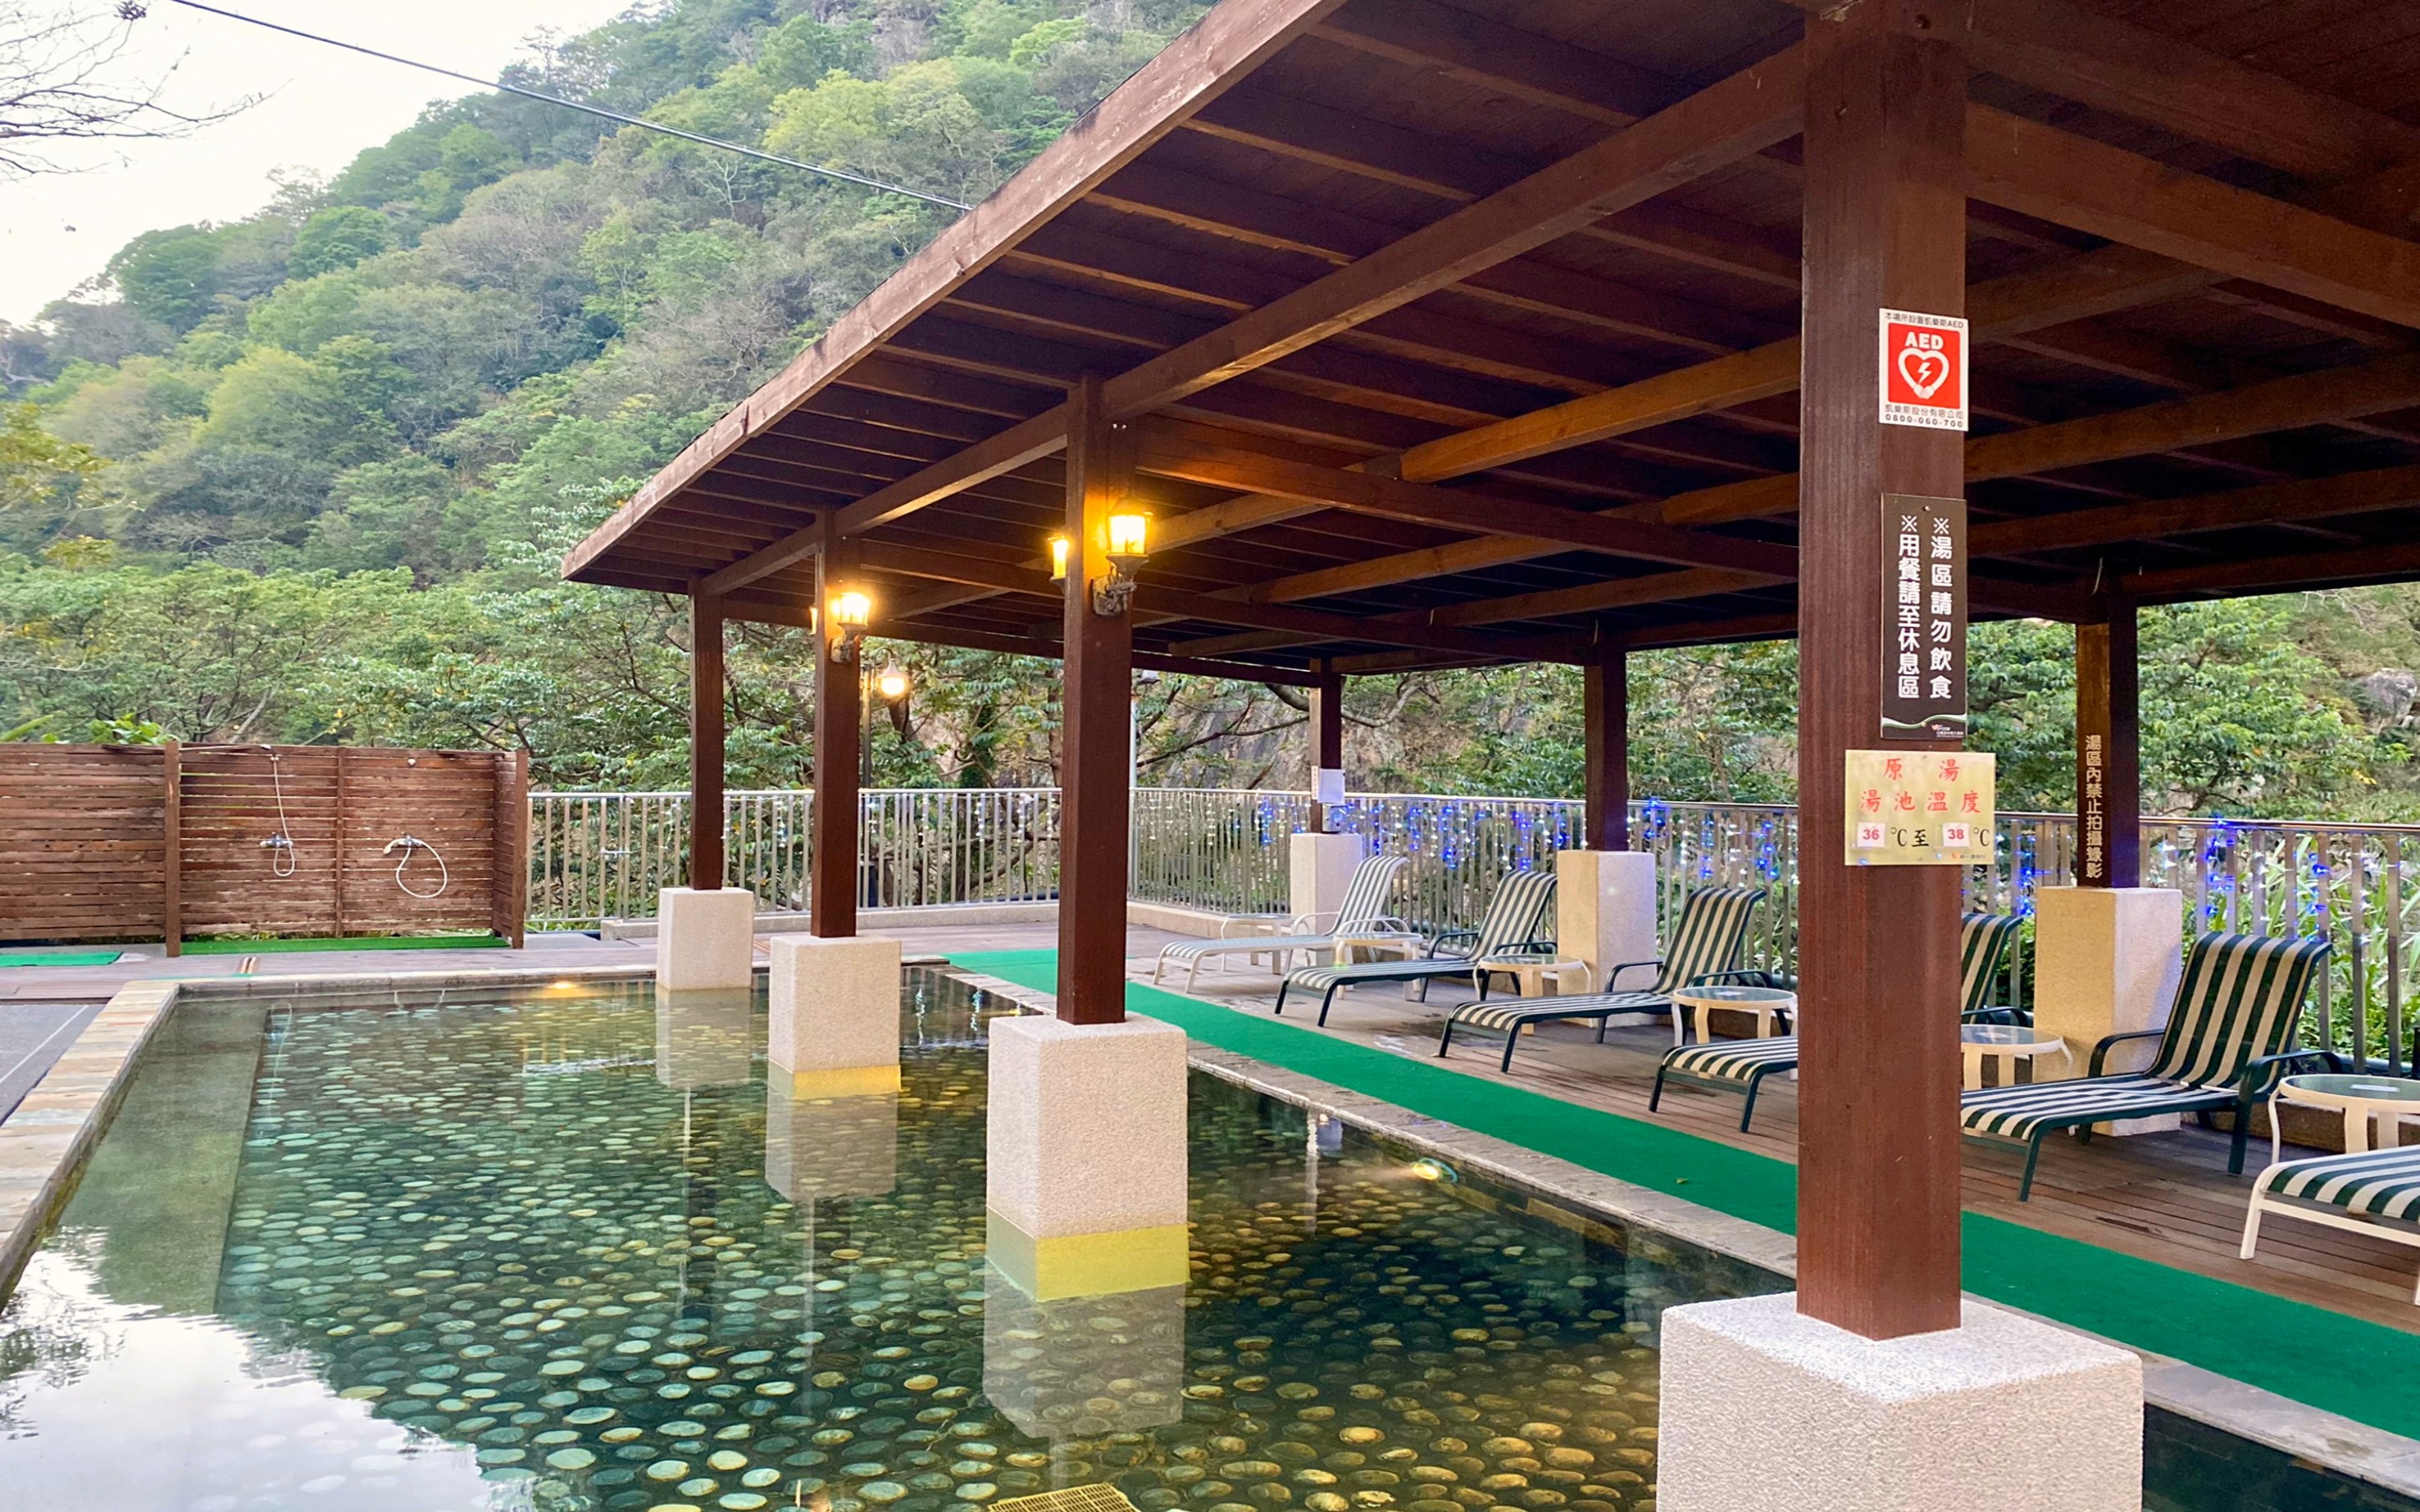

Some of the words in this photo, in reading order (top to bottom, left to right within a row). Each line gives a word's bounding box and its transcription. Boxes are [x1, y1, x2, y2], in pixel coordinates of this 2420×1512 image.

[1904, 332, 1944, 350] AED
[1885, 414, 1963, 428] 0800-060-700
[1859, 789, 1981, 814] 湯池溫度
[2085, 734, 2102, 879] 湯區內禁止拍攝錄影
